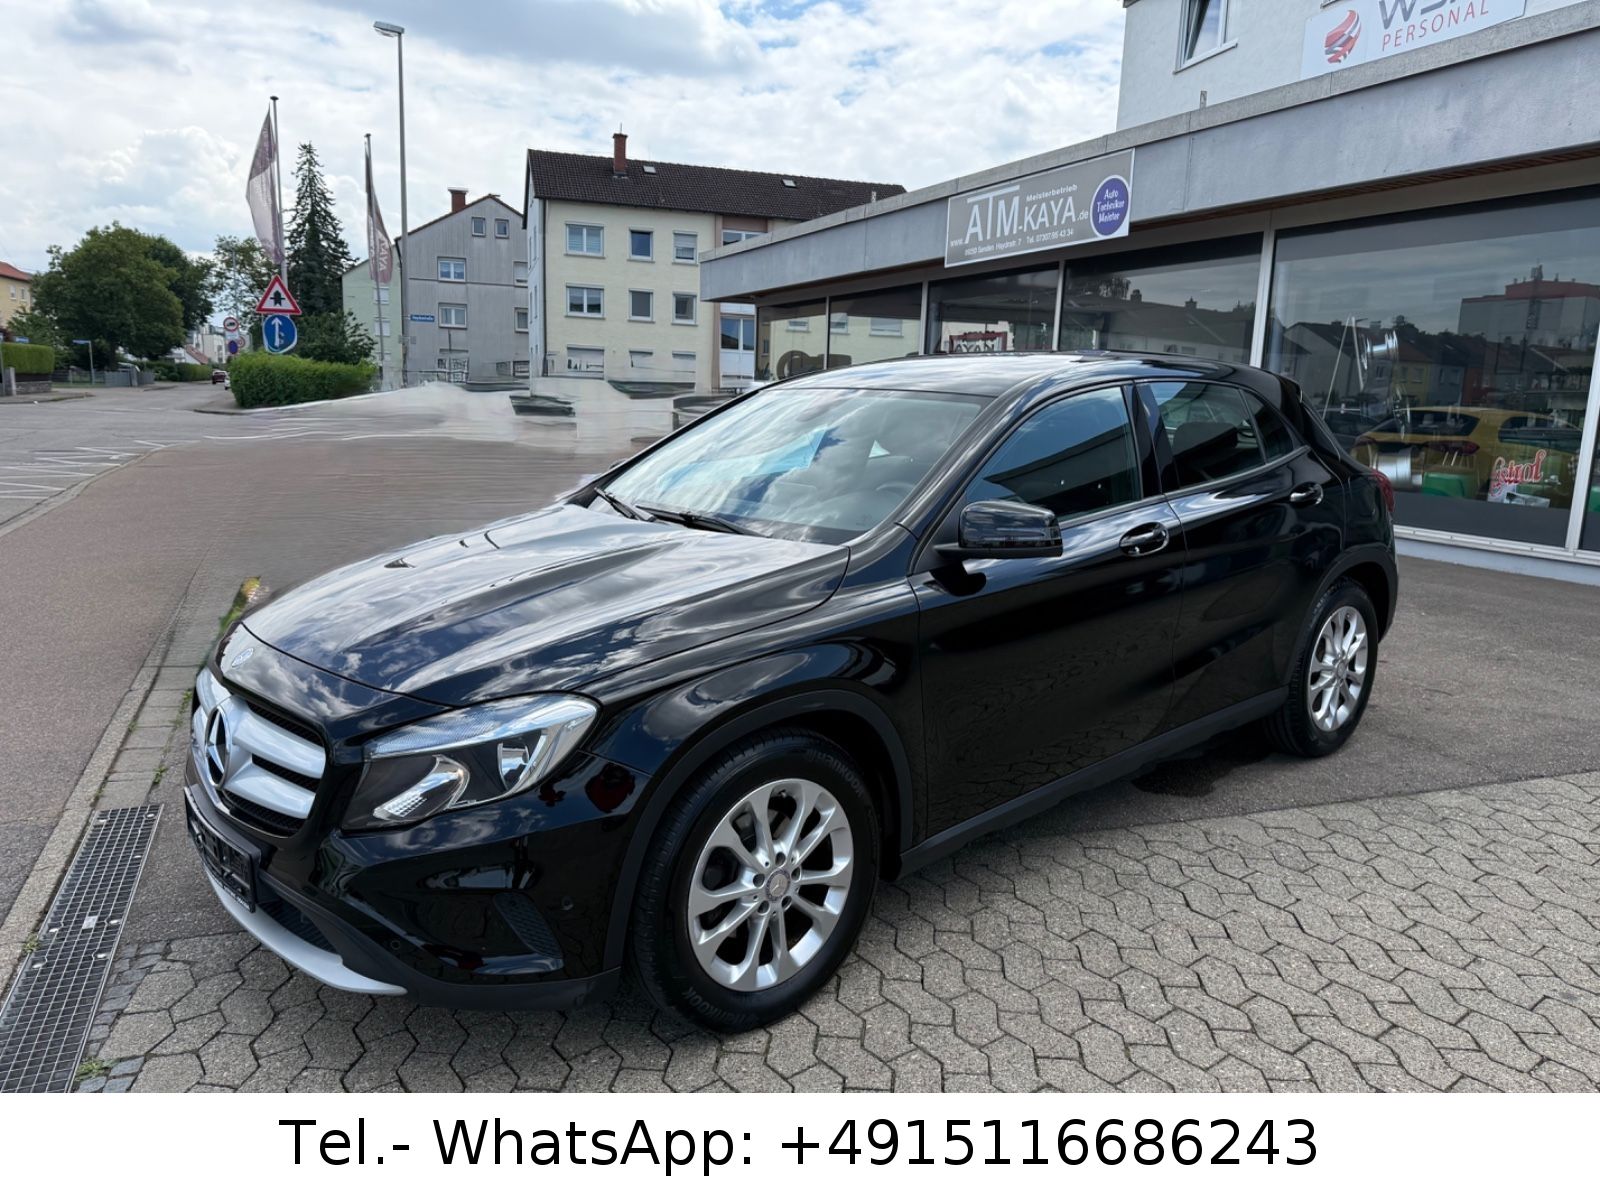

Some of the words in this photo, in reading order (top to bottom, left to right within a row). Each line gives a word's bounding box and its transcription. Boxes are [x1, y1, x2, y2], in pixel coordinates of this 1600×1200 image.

[1381, 0, 1490, 52] PERSONAL
[1026, 184, 1078, 202] Meisterbetrieb
[1104, 189, 1119, 200] Auto
